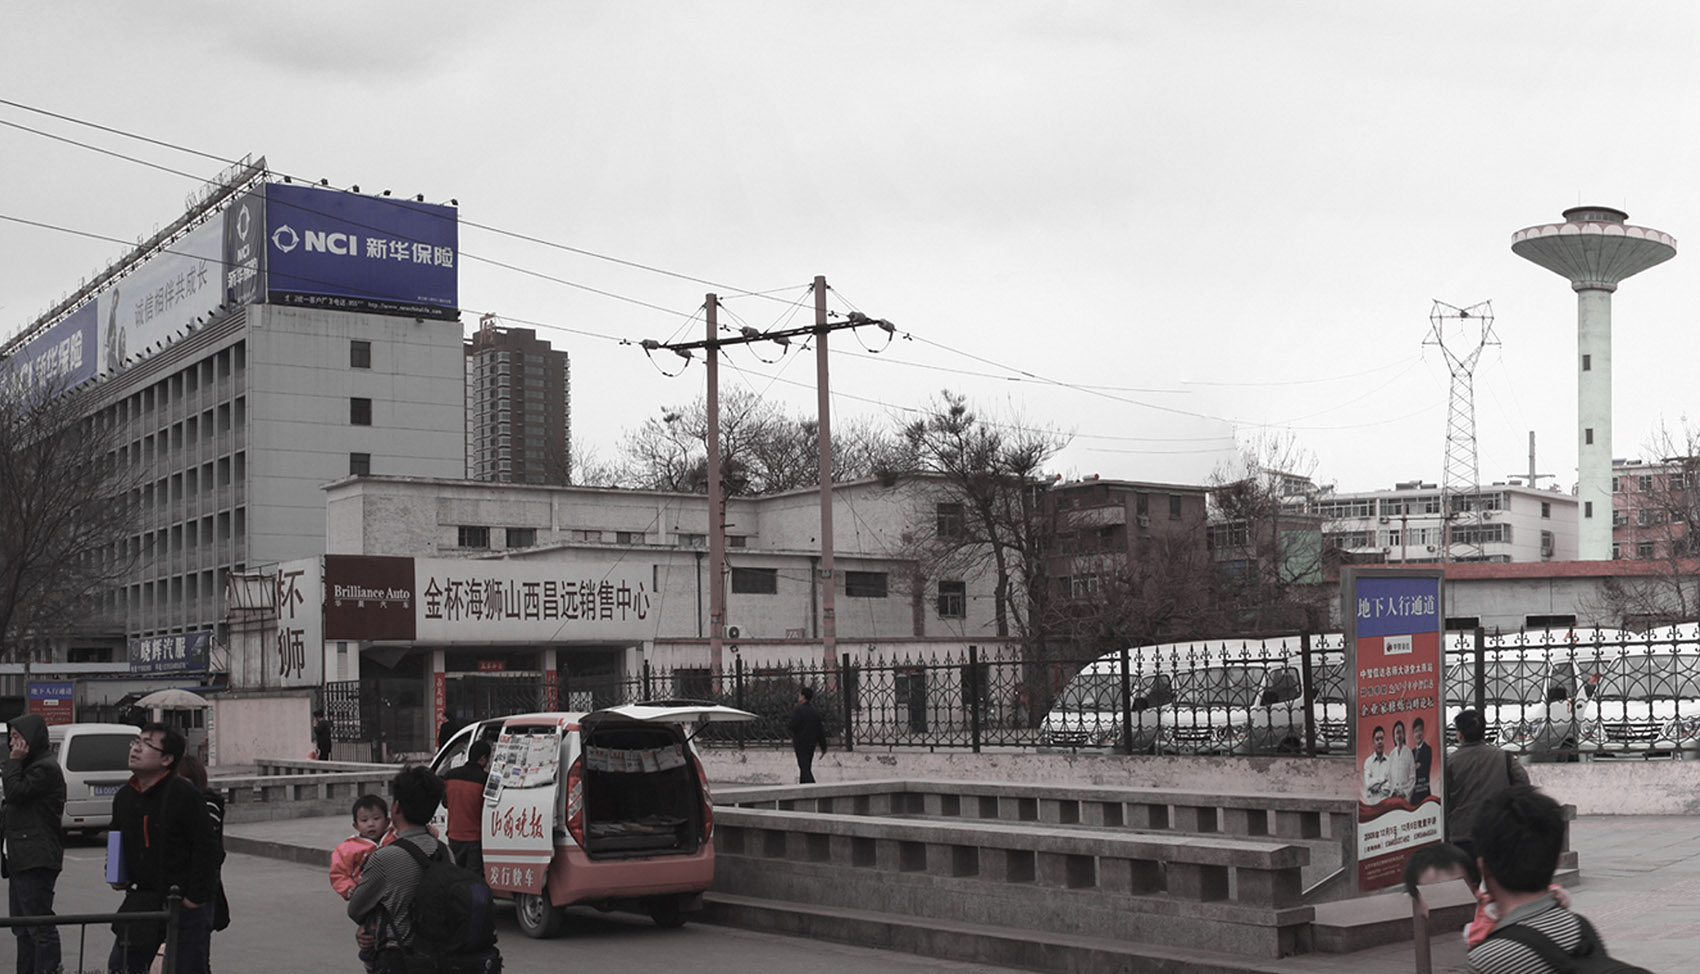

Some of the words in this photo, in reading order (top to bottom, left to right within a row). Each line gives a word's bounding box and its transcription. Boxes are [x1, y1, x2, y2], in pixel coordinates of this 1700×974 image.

[305, 230, 358, 256] NCI
[365, 237, 454, 268] 新华保险
[134, 260, 208, 328] 诚信相伴共成长
[334, 584, 385, 599] Brilliance
[385, 586, 410, 600] Auto
[423, 575, 650, 622] 金杯海狮山西昌远销售中心
[1357, 595, 1435, 618] 地下人行通道
[489, 866, 535, 888] 发行快车
